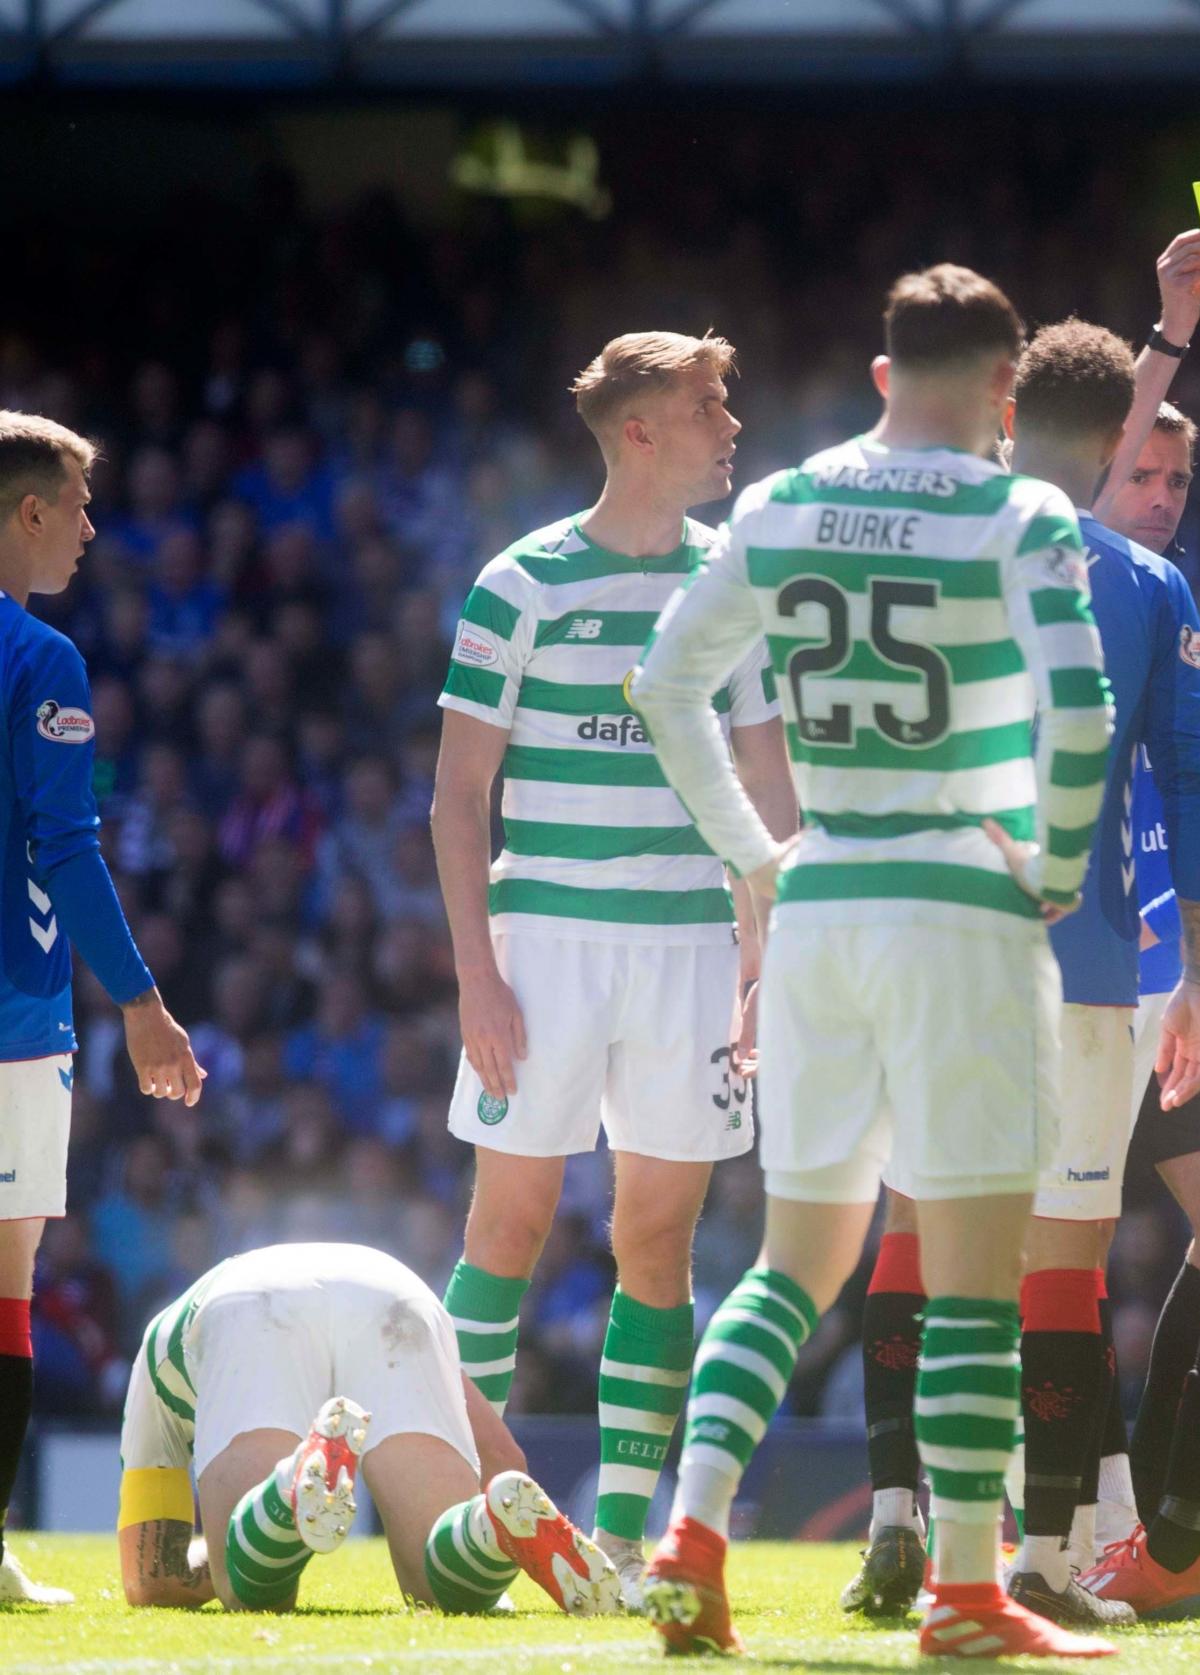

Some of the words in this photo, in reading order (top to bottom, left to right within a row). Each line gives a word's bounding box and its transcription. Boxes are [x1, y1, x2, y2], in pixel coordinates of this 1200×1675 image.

[817, 508, 922, 551] BURKE
[777, 572, 953, 750] 25
[1141, 822, 1168, 853] ut
[1067, 1166, 1110, 1181] hummel
